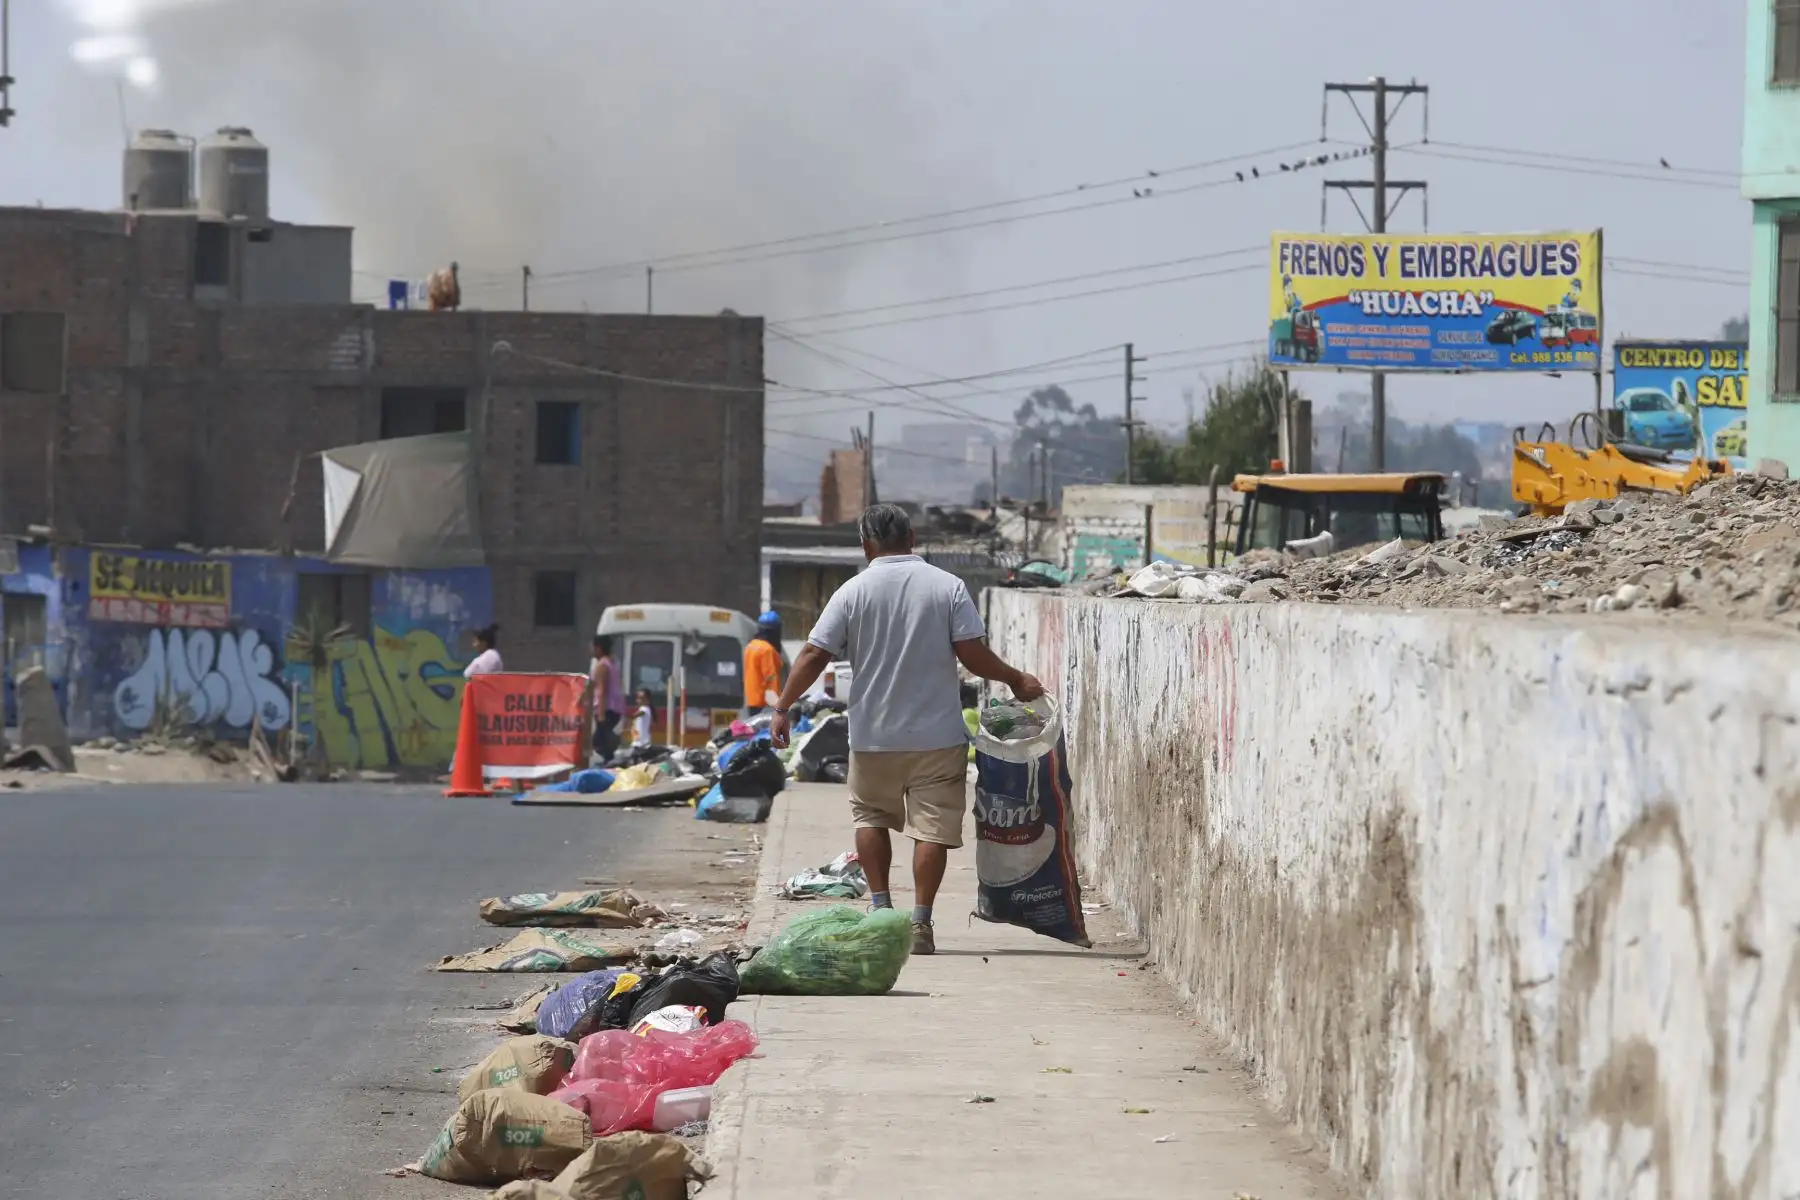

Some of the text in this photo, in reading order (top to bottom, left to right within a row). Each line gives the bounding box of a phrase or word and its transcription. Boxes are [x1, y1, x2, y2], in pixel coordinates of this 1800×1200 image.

[1279, 241, 1580, 279] FRENOS Y EMBRAGUES
[1620, 348, 1705, 370] CENTRO
[1709, 349, 1738, 369] DE
[96, 554, 226, 599] SE ALQUILA
[503, 693, 554, 713] CALLE
